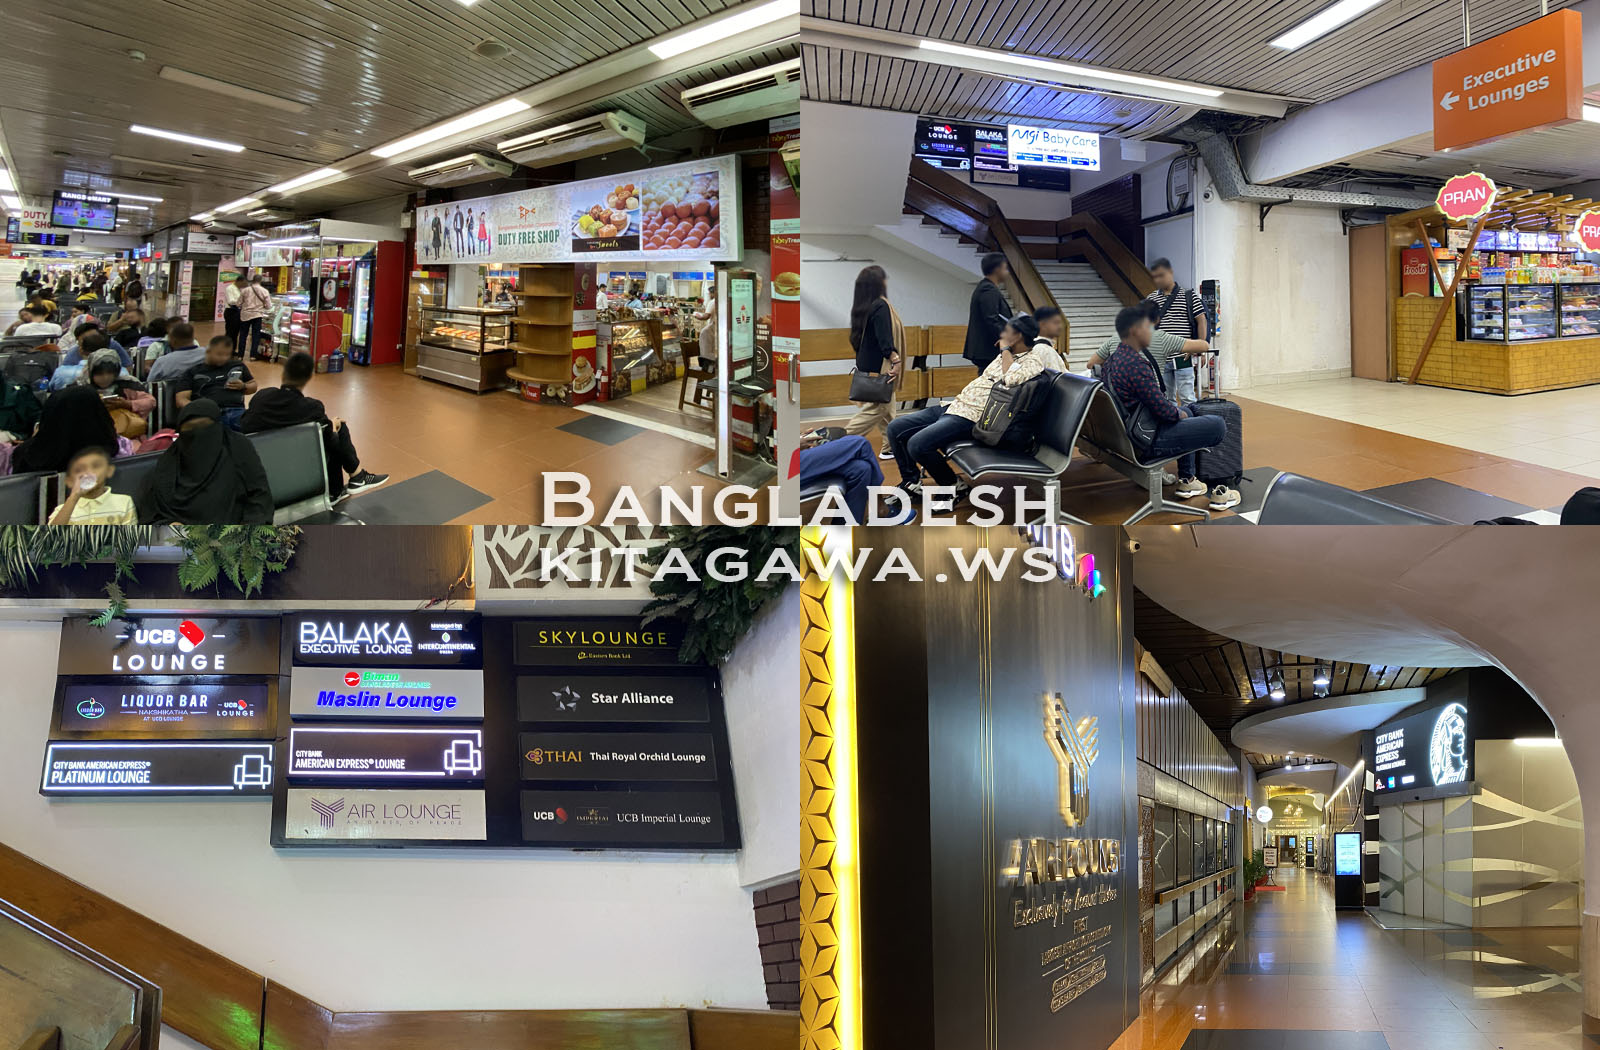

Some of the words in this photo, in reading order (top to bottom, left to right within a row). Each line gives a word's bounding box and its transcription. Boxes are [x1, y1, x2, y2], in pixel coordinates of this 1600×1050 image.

[1463, 49, 1557, 91] Executive
[1468, 75, 1550, 111] Lounges
[1043, 131, 1070, 148] Baby
[1071, 135, 1098, 148] Care
[1443, 186, 1486, 207] PRAN
[23, 210, 48, 220] DUTY
[498, 232, 516, 245] DUTY
[518, 231, 535, 245] FREE
[537, 229, 560, 244] SHOP
[135, 629, 176, 644] UCB
[300, 622, 412, 644] BALAKA
[539, 631, 667, 645] SKYLOUNGE
[300, 644, 360, 654] EXECUTIVE
[366, 644, 412, 654] LOUNGE
[112, 654, 225, 671] LOUNGE
[363, 671, 400, 681] Biman
[121, 694, 172, 707] LIQUOR
[179, 694, 208, 707] BAR
[317, 690, 381, 708] Maslin
[385, 691, 457, 712] Lounge
[591, 693, 618, 704] Star
[621, 692, 674, 704] Alliance
[1376, 733, 1389, 745] CITY
[1376, 738, 1404, 755] AMERICAN
[295, 750, 308, 758] CITY
[308, 750, 323, 758] BANK
[544, 751, 582, 762] THAI
[590, 752, 610, 761] Thai
[612, 752, 637, 763] Royal
[639, 752, 670, 761] Orchid
[672, 753, 706, 764] Lounge
[1376, 750, 1400, 764] EXPRESS
[53, 761, 68, 770] CITY
[68, 761, 86, 769] BANK
[86, 761, 118, 769] AMERICAN
[295, 758, 335, 769] AMERICAN
[375, 759, 406, 769] LOUNGE
[51, 771, 106, 784] PLATINUM
[107, 771, 151, 784] LOUNGE
[347, 803, 376, 819] AIR
[383, 803, 462, 820] LOUNGE
[533, 811, 555, 821] UCB
[617, 813, 639, 822] UCB
[641, 813, 677, 824] Imperial
[679, 813, 711, 825] Lounge
